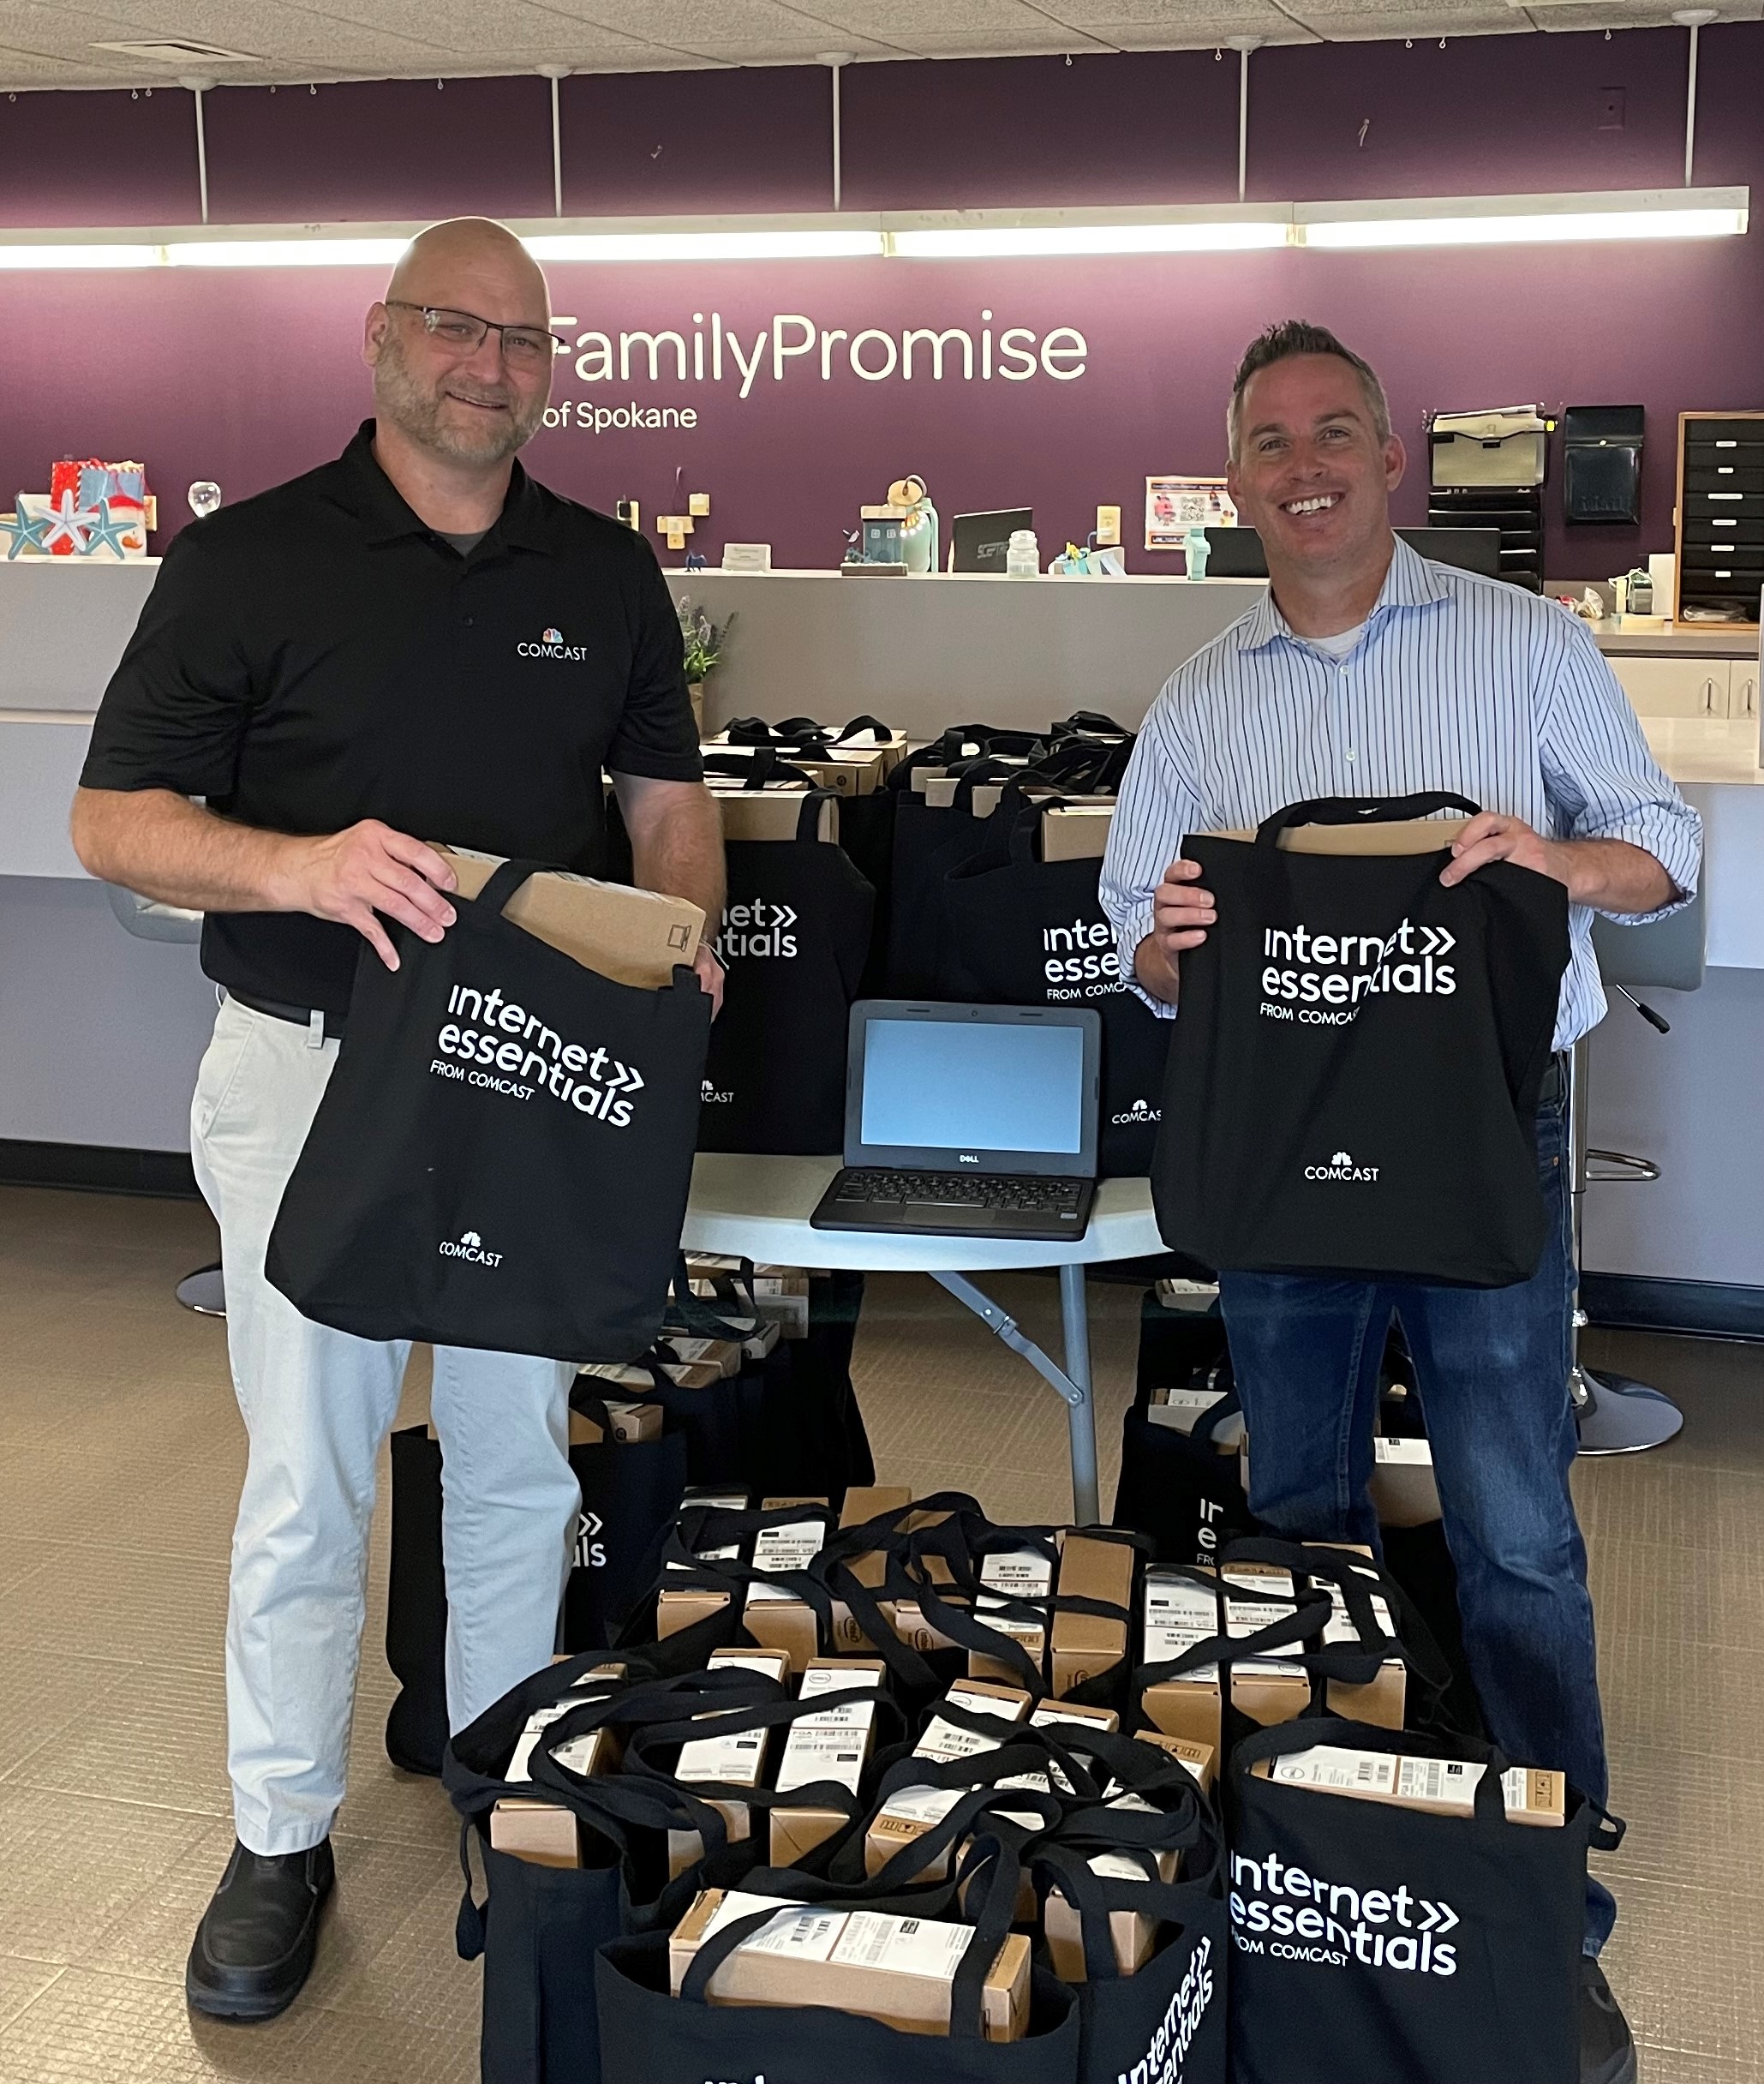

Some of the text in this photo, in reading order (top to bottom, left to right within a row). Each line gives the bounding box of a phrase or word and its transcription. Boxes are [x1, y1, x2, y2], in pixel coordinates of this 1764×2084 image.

[542, 401, 698, 435] of Spokane
[517, 642, 588, 661] COMCAST
[1047, 988, 1082, 1000] FROM
[1259, 1003, 1295, 1021] FROM
[447, 985, 609, 1082] Internet
[430, 1060, 535, 1101] FROM COMCAST
[438, 1024, 635, 1128] essentials
[960, 1154, 979, 1163] DELL
[1304, 1165, 1379, 1182] COMCAST
[439, 1241, 503, 1267] COMCAST
[1230, 1892, 1456, 1976] essentials
[1270, 1943, 1348, 1967] COMCAST
